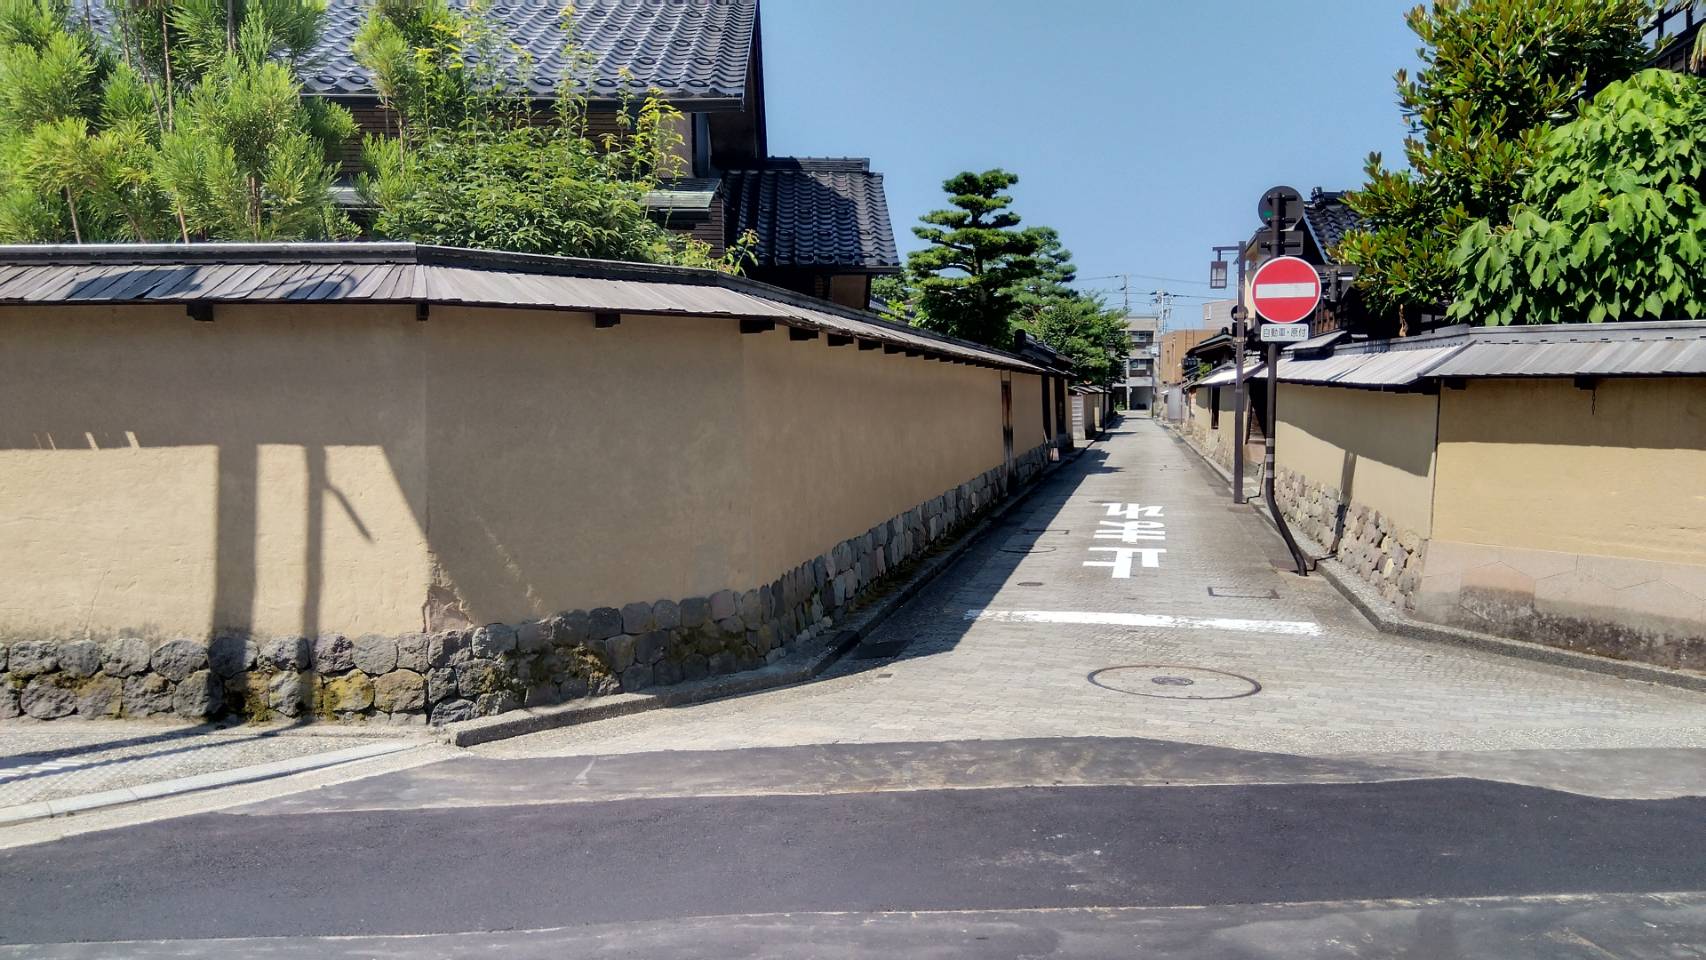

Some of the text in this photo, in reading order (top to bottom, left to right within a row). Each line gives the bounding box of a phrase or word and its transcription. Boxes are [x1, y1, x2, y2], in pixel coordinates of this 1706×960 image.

[1263, 327, 1306, 338] 自動車・原付
[1082, 502, 1168, 579] 止まれ
